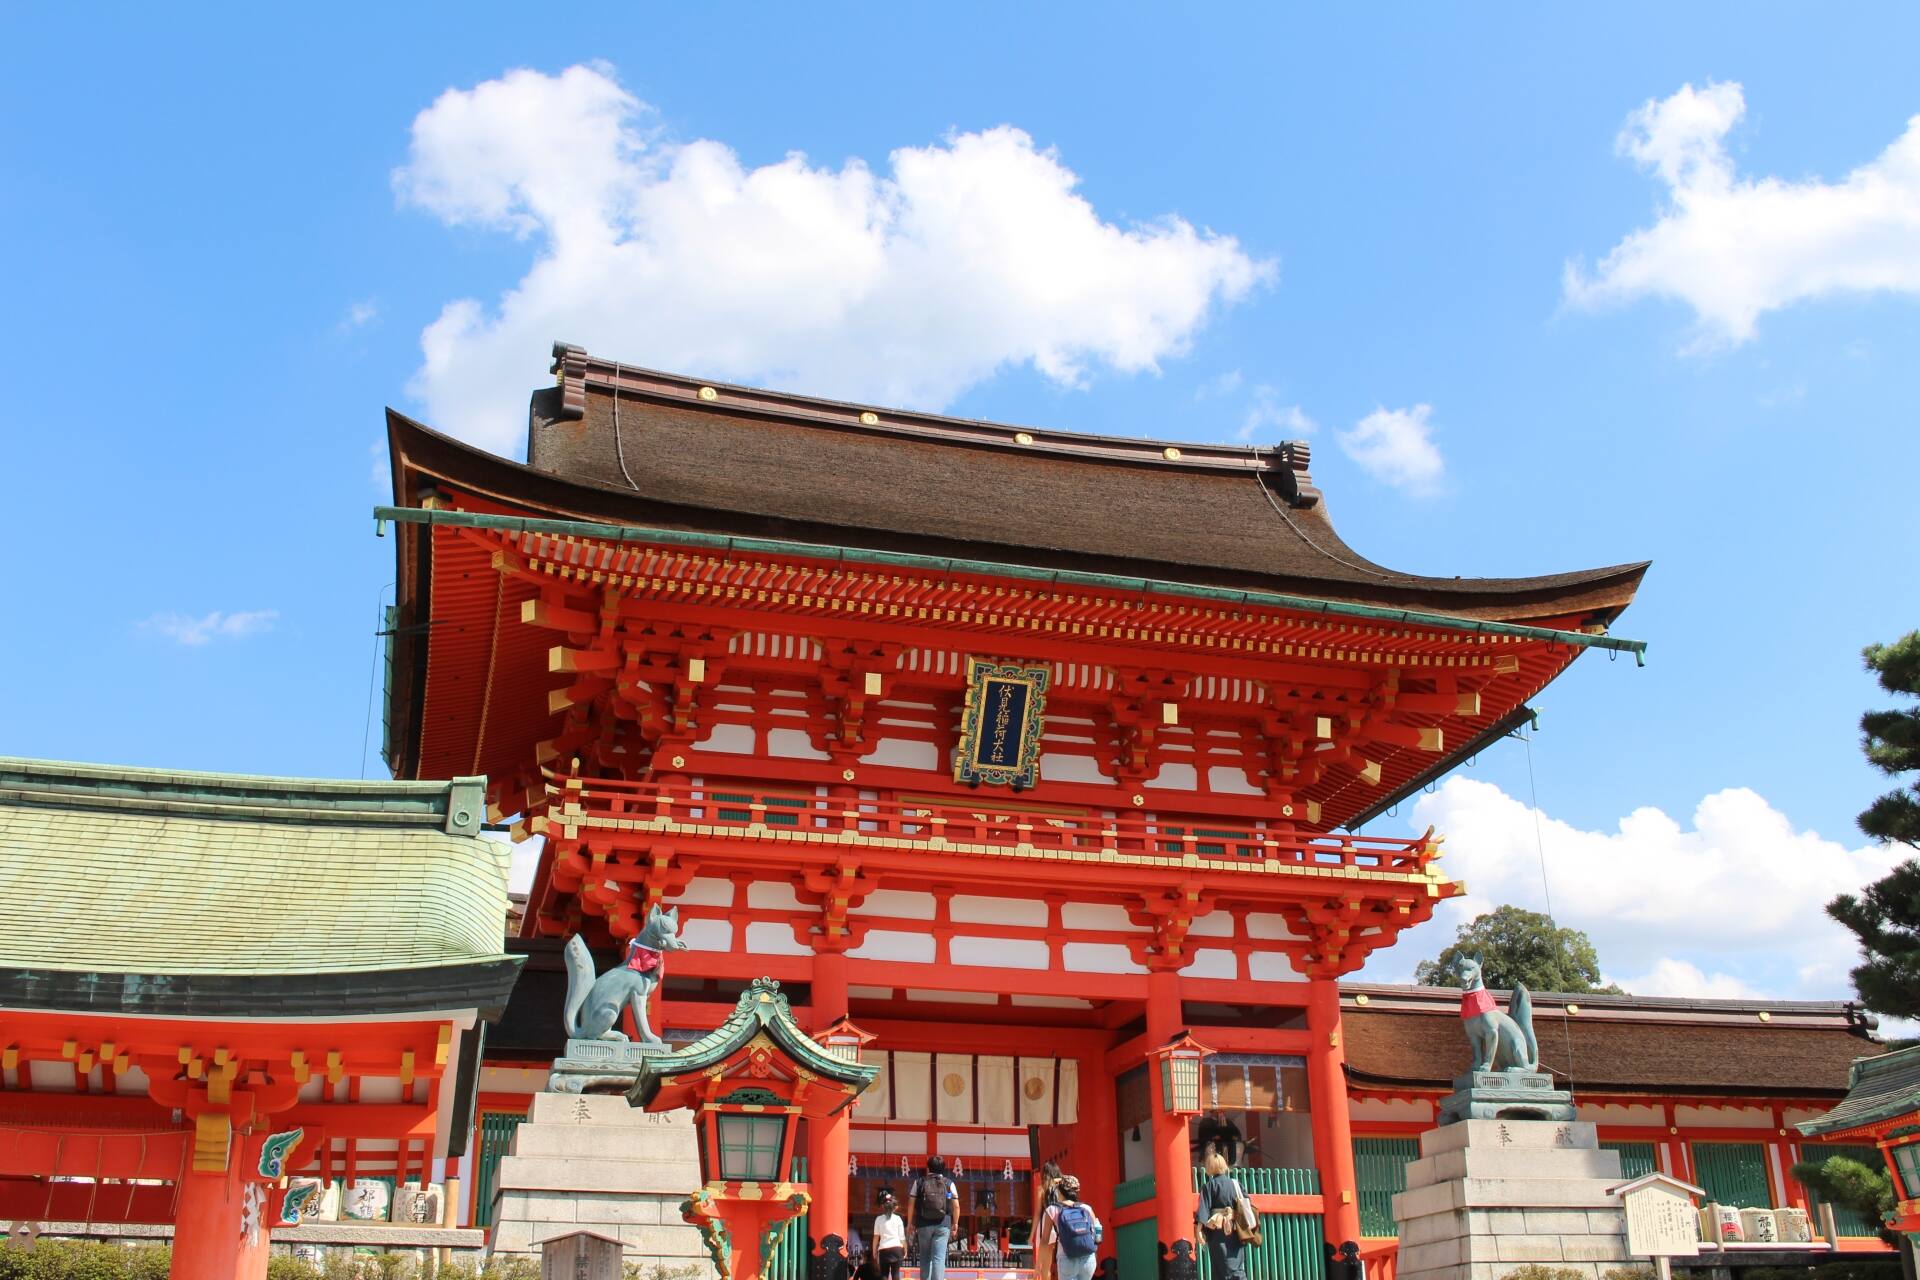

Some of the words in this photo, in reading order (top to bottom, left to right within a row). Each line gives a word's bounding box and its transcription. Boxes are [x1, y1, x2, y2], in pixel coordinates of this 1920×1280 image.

[991, 684, 1015, 763] 伏見稲荷大社
